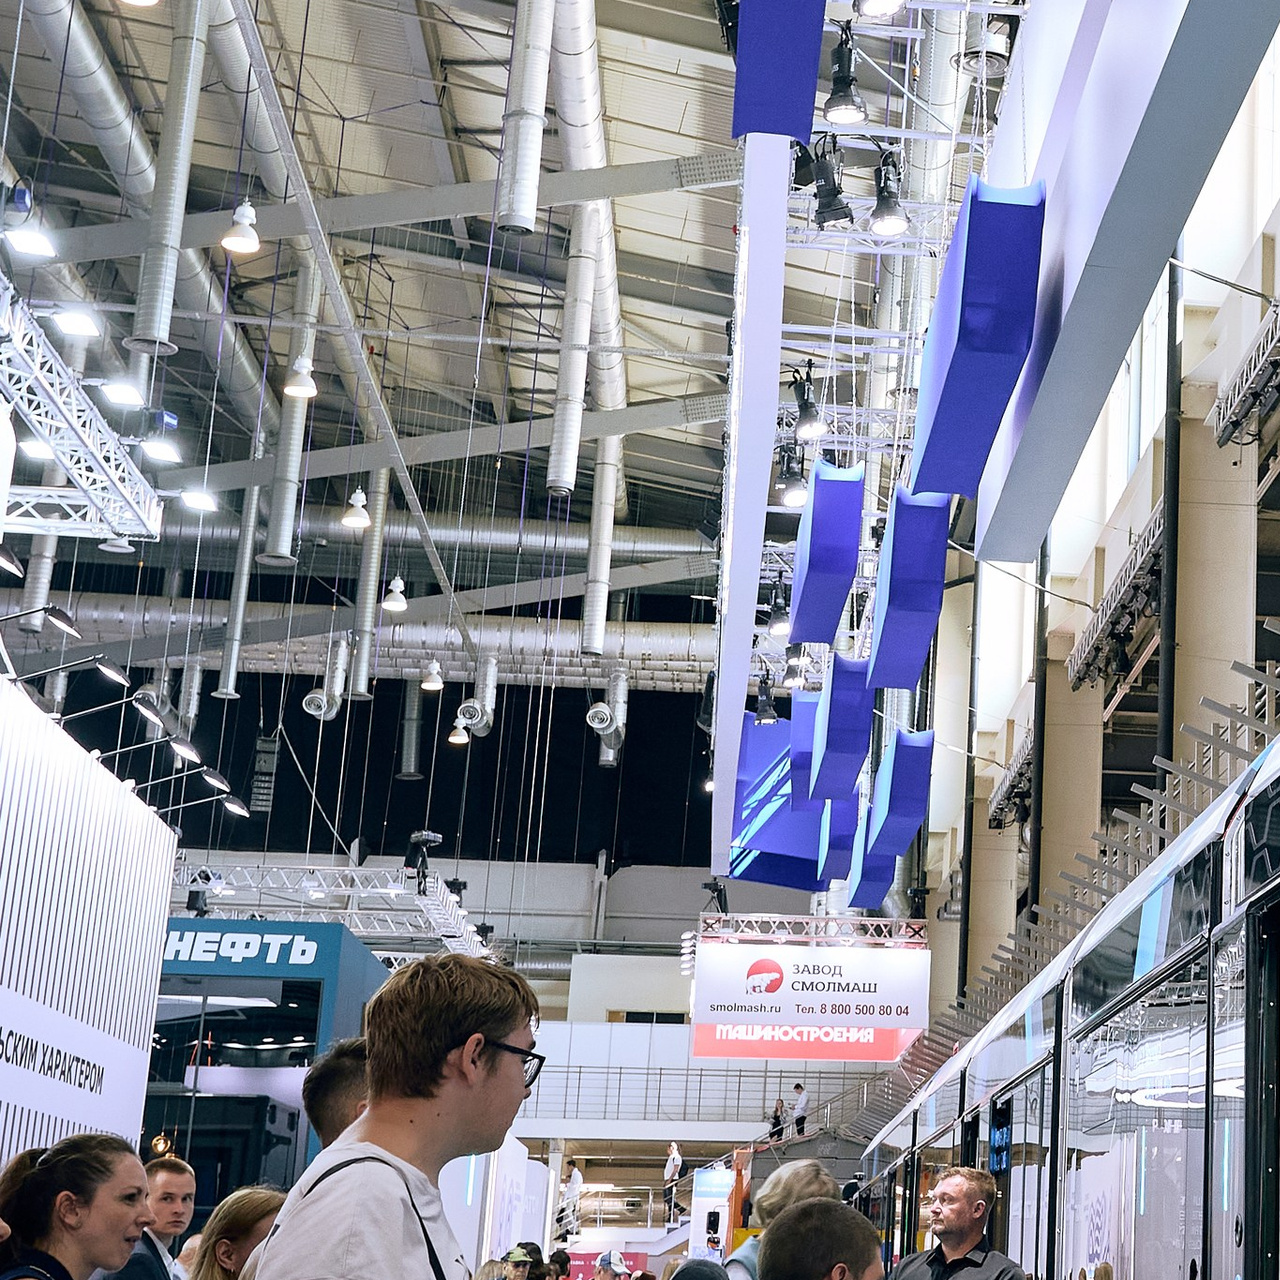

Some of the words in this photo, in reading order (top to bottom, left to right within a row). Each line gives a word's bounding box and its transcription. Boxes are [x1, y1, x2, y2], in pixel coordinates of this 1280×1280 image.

[163, 931, 318, 965] НЕФТЬ
[792, 964, 842, 977] ЗАВОД
[791, 981, 878, 993] СМОЛМАШ
[709, 1003, 781, 1013] smolmash.ru
[795, 1004, 816, 1014] Тел.
[820, 1004, 827, 1014] 8
[830, 1004, 851, 1015] 800
[855, 1004, 875, 1015] 500
[878, 1005, 892, 1016] 80
[896, 1005, 910, 1016] 04
[715, 1024, 875, 1043] МАШИНОСТРОЕНИЯ
[39, 1043, 104, 1095] ХАРАКТЕРОМ
